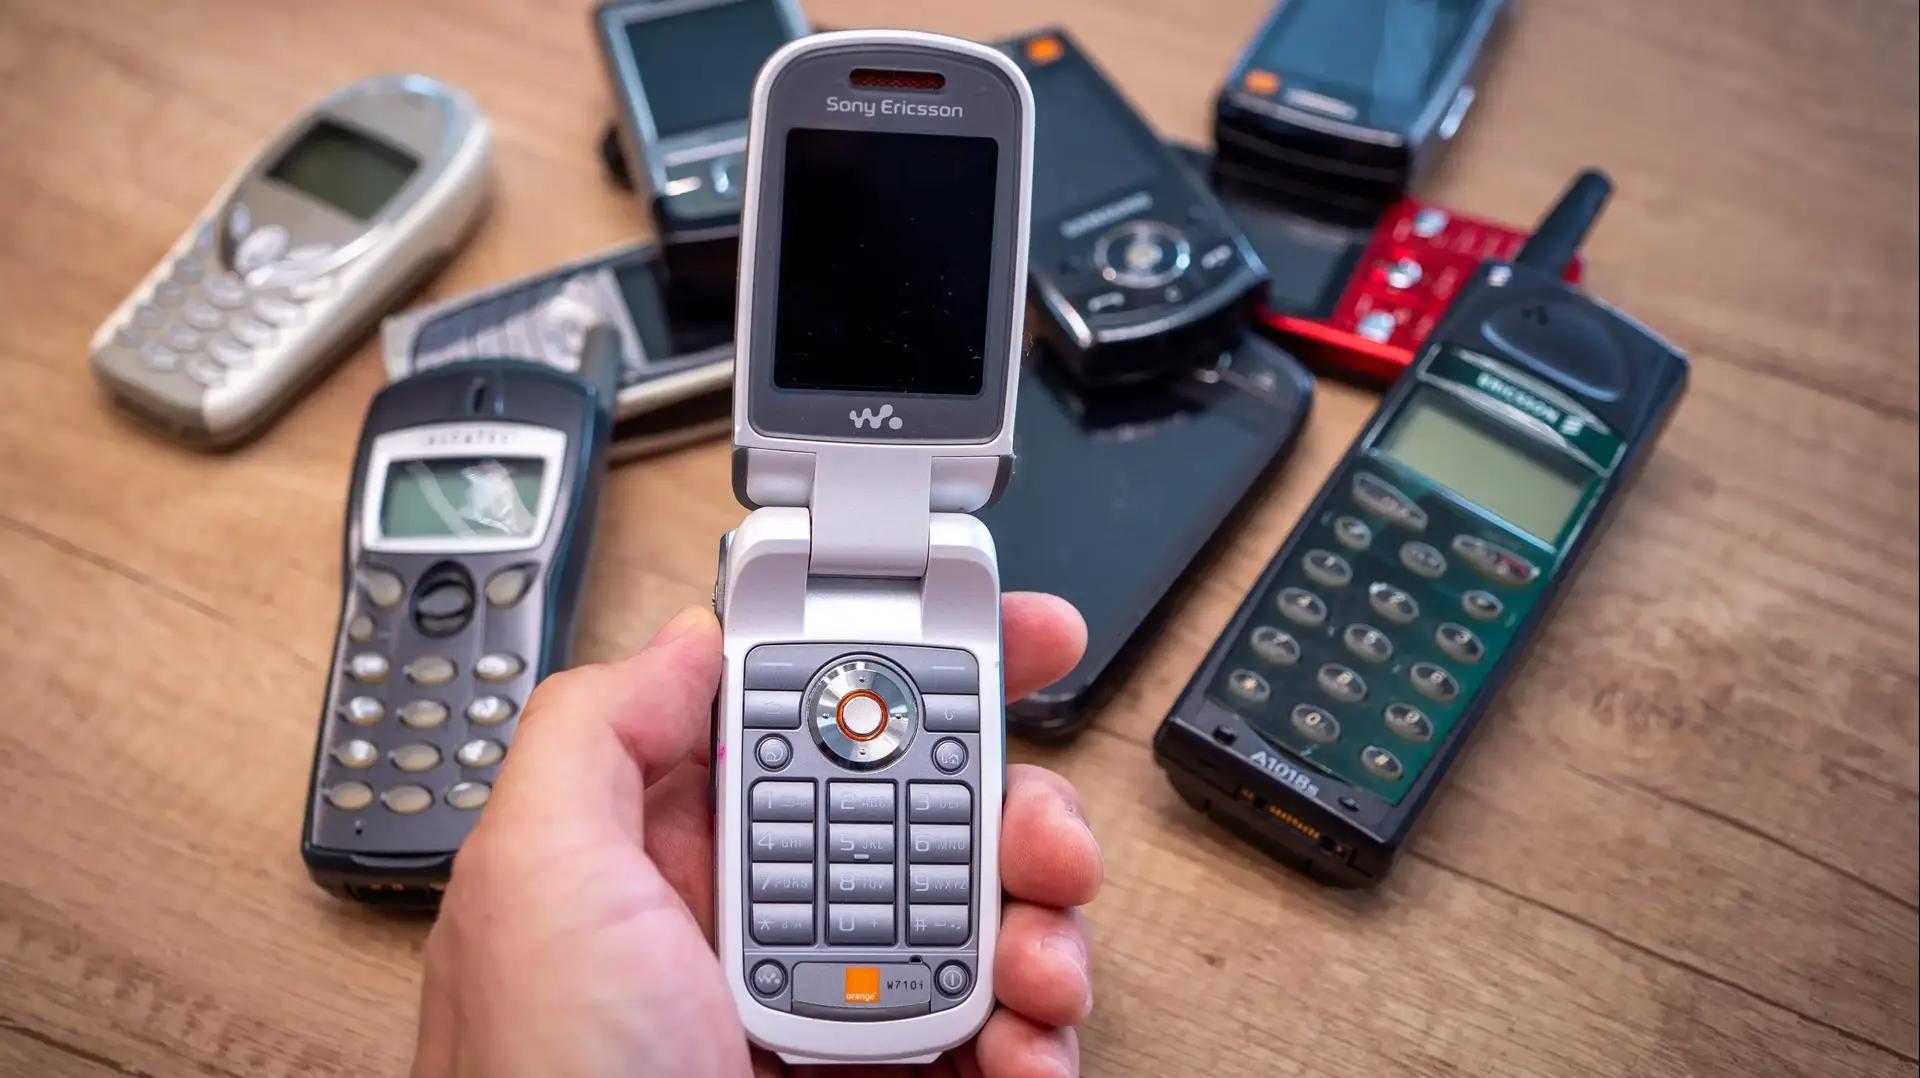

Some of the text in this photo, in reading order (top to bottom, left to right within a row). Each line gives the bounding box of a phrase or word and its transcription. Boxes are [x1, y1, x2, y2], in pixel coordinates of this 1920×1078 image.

[826, 96, 964, 117] Sony Ericsson
[1305, 712, 1321, 726] 0
[1250, 750, 1320, 798] A1018s
[840, 791, 887, 810] 2 ABC
[914, 793, 930, 811] 3
[757, 831, 775, 850] 4
[840, 833, 855, 851] 5
[914, 833, 930, 852] 6
[774, 877, 808, 889] PQRS
[839, 871, 885, 891] 8 TUV
[914, 873, 969, 892] 9 WXYZ
[846, 980, 925, 1002] orange W710i
